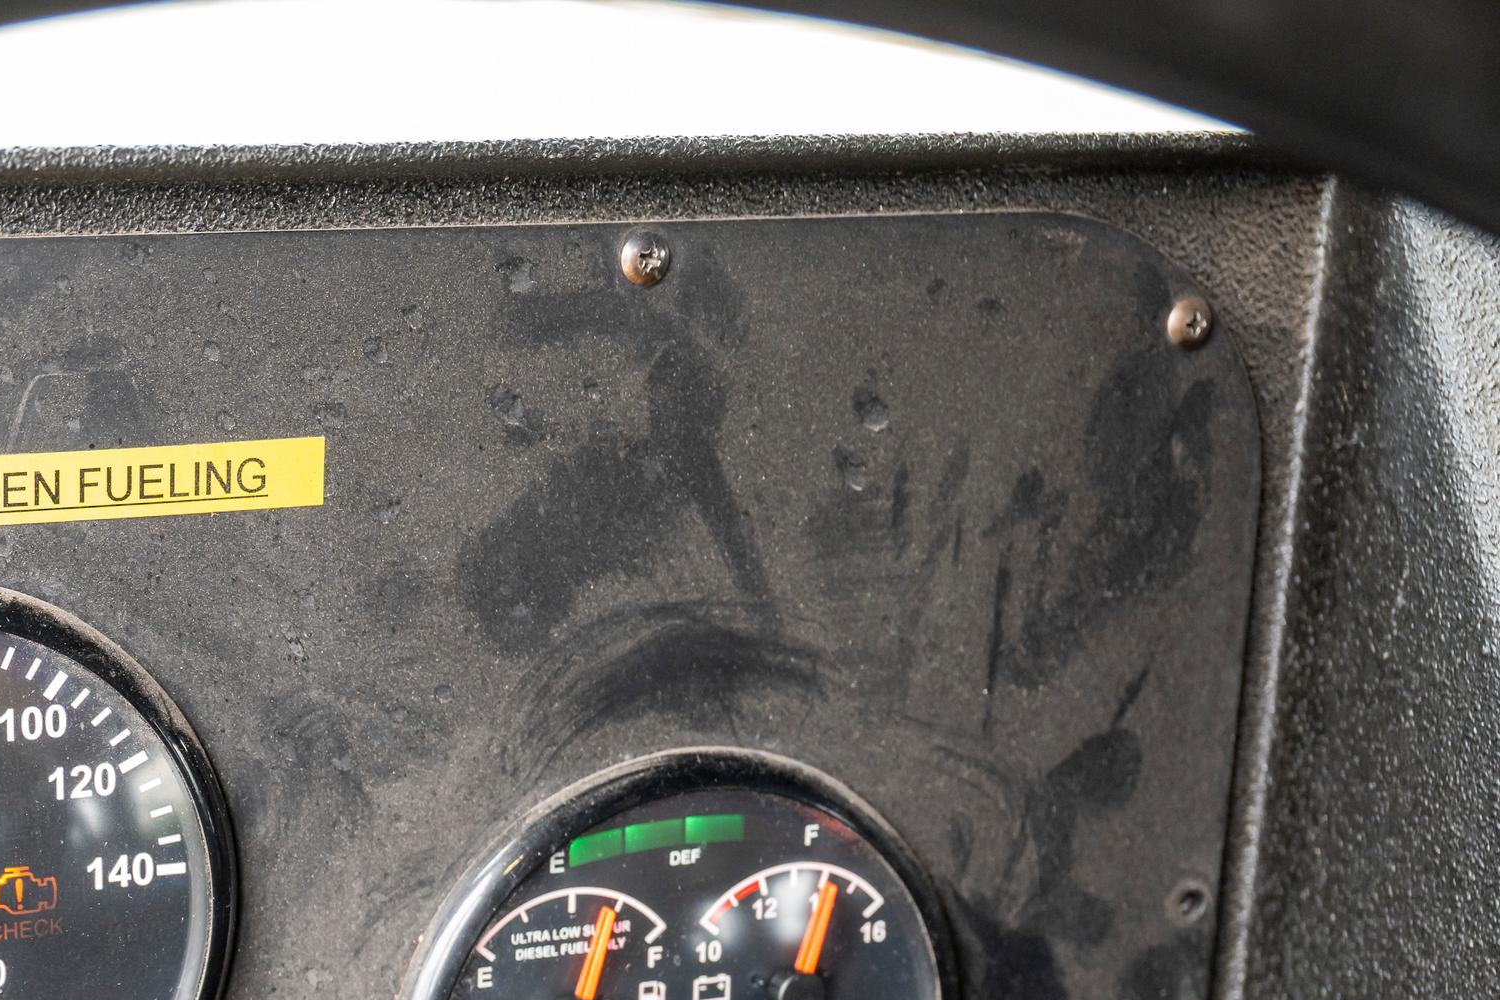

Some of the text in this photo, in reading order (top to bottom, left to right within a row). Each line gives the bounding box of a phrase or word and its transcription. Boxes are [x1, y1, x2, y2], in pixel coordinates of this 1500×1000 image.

[79, 457, 268, 504] FUELING
[48, 763, 117, 800] 120
[804, 824, 820, 847] F
[549, 852, 565, 874] E
[668, 849, 702, 868] DEF
[86, 852, 155, 890] 140
[752, 897, 778, 920] 12
[511, 930, 550, 945] ULTRA
[552, 925, 581, 941] LOW
[860, 920, 887, 944] 16
[515, 944, 559, 961] DIESEL
[560, 941, 591, 956] FUEL
[647, 946, 663, 968] F
[695, 942, 722, 963] 10
[477, 966, 493, 989] E
